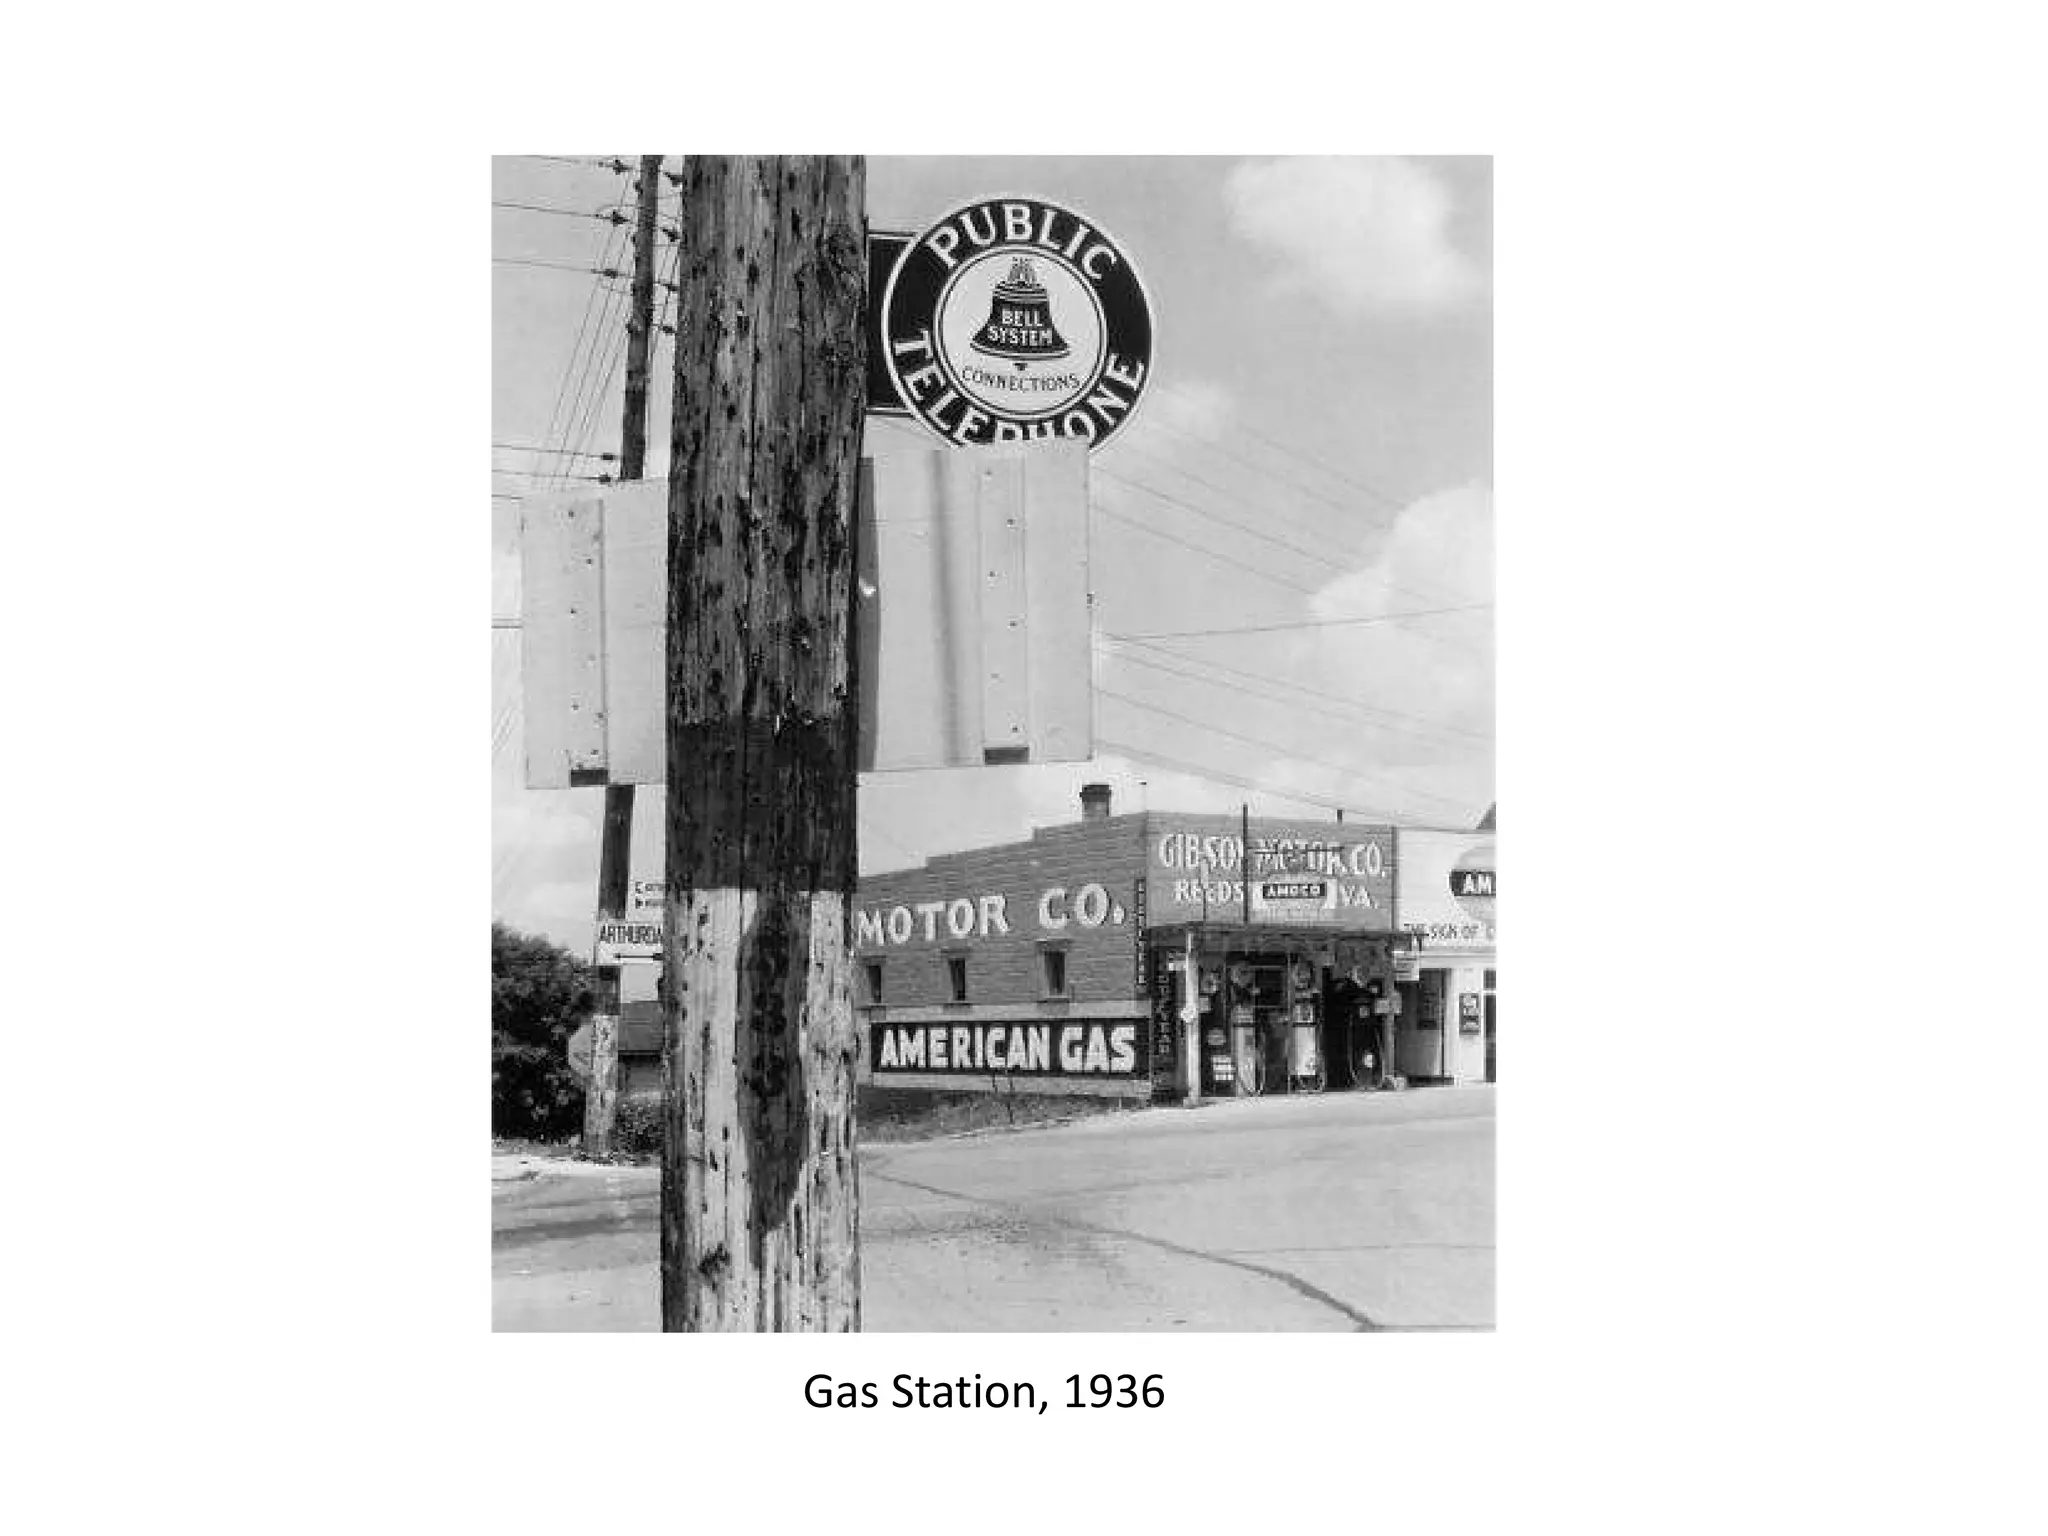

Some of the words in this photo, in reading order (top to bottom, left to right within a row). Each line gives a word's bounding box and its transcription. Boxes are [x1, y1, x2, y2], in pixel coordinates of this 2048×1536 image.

[925, 203, 1116, 279] PUBLIC
[987, 326, 1052, 346] SYSTEM
[1002, 310, 1043, 327] BELL
[962, 366, 1081, 392] CONNECTIONS
[1159, 833, 1244, 873] GIBSO
[857, 895, 1009, 945] MOTOR
[1039, 883, 1126, 930] CO.
[880, 1025, 1050, 1069] AMERICAN
[1060, 1025, 1135, 1072] GAS
